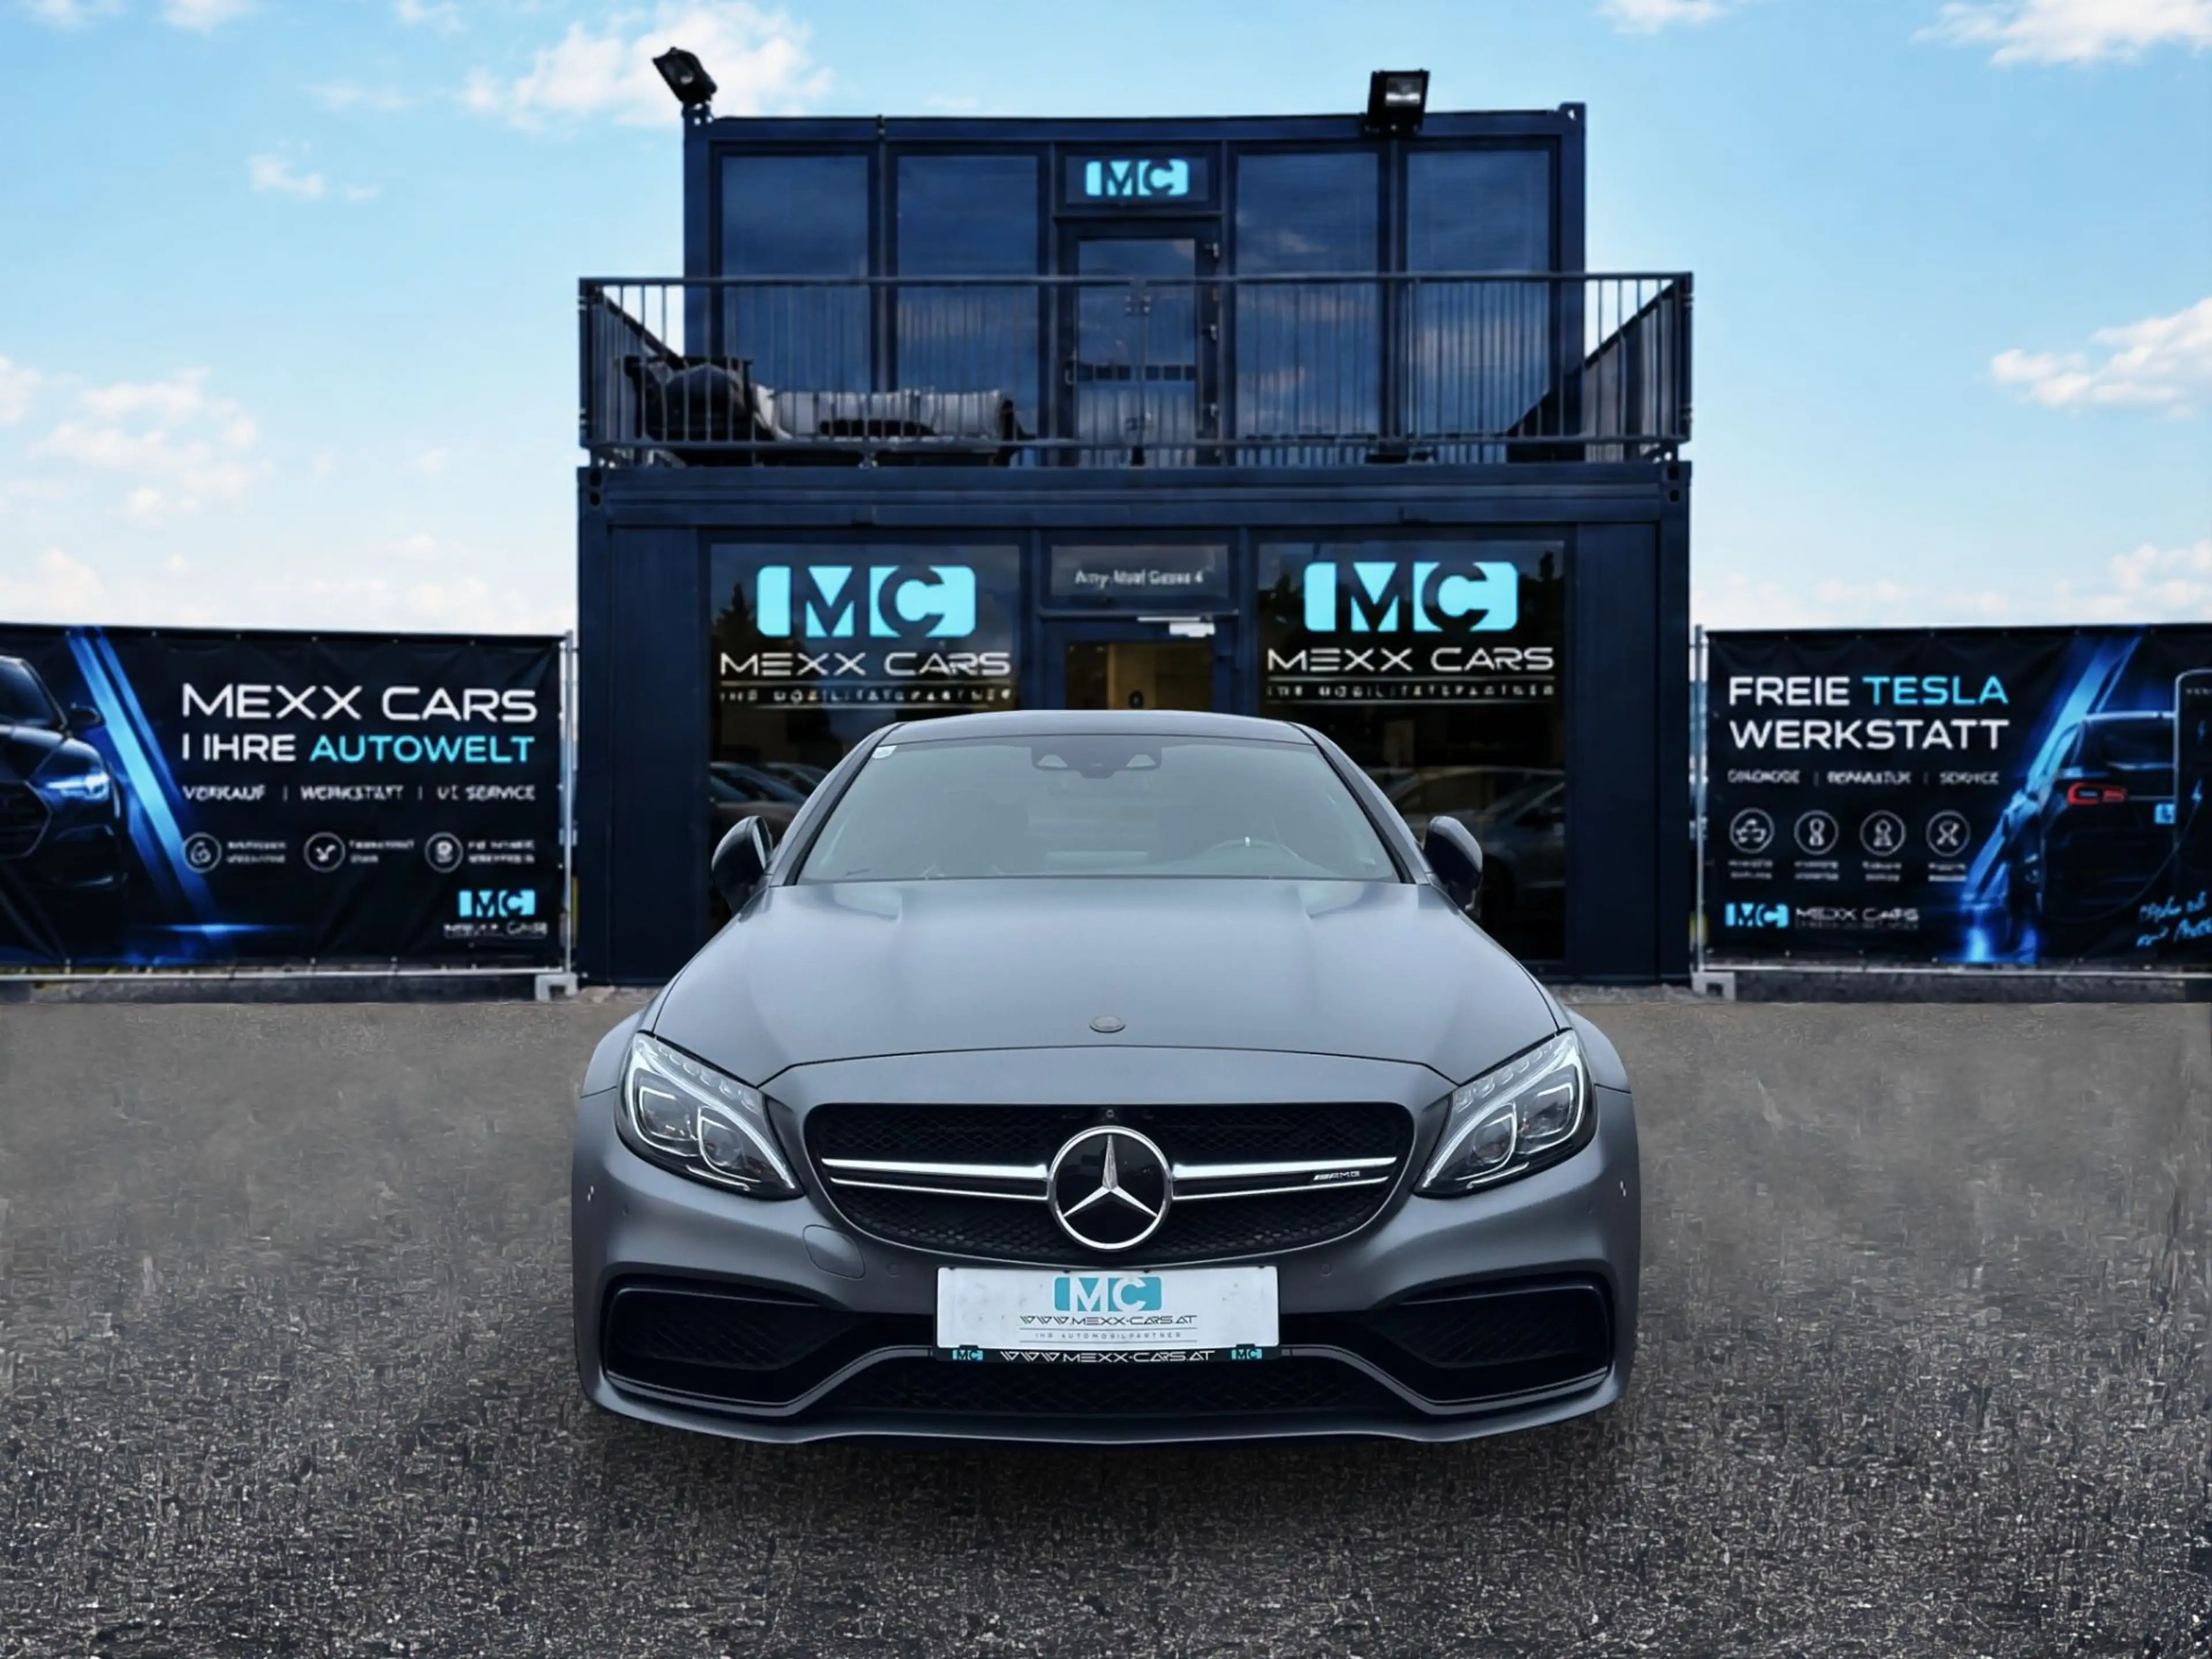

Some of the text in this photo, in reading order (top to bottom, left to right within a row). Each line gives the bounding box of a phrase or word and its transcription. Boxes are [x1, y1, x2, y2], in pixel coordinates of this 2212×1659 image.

[1099, 160, 1177, 196] MC
[788, 565, 948, 638] MC
[1334, 562, 1492, 632] MC
[720, 652, 1012, 677] MEXX CARS
[1267, 646, 1555, 672] MEXX CARS
[181, 683, 538, 722] MEXX CARS
[1729, 675, 2009, 706] FREIE TESLA
[203, 733, 296, 762] IHRE
[309, 734, 536, 763] AUTOWELT
[1729, 719, 2010, 749] WERKSTATT
[469, 889, 527, 917] MC
[1734, 902, 1781, 928] MC
[1067, 1275, 1149, 1312] MC
[955, 1349, 980, 1361] MC
[1234, 1348, 1259, 1360] MC
